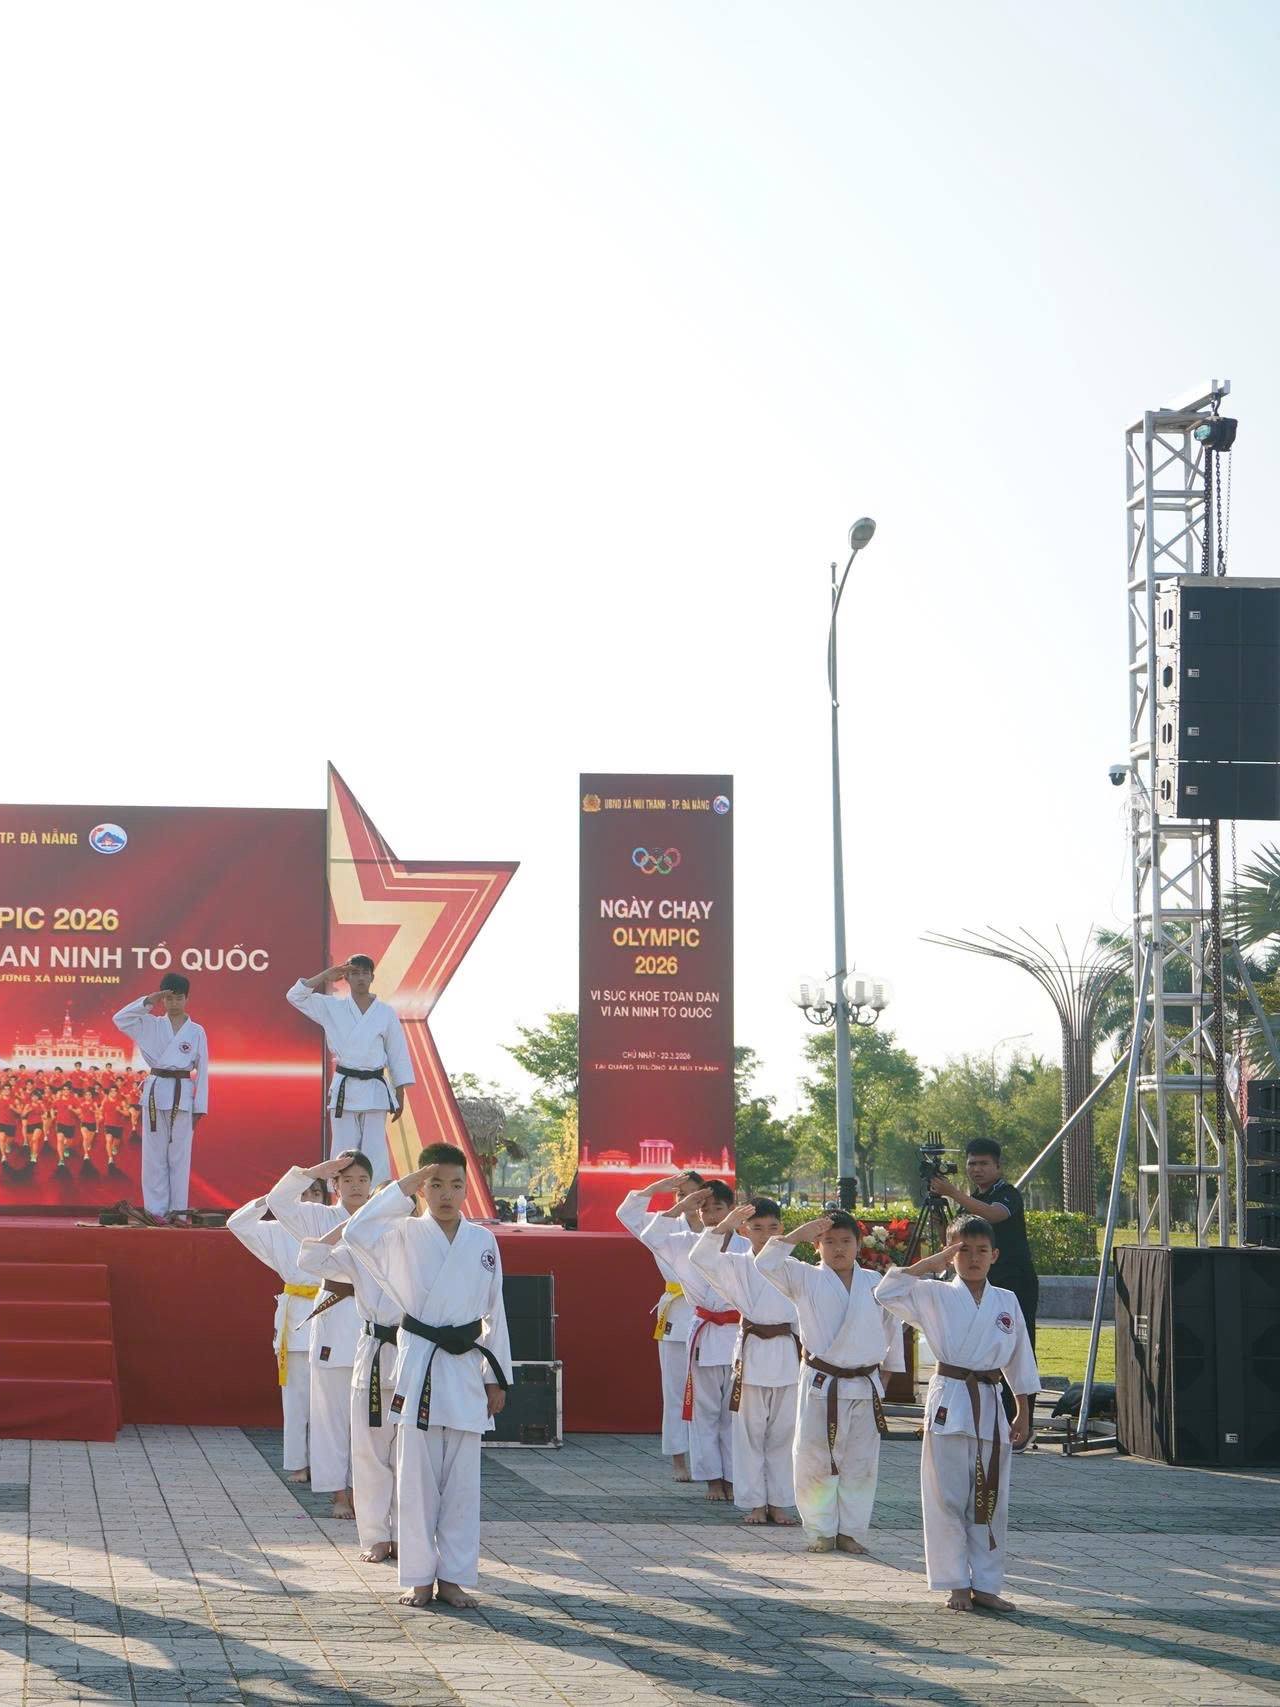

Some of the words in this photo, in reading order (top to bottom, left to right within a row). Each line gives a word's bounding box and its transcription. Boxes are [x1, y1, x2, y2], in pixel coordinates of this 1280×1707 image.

[0, 832, 17, 844] TP.
[20, 830, 38, 845] ĐÀ
[53, 907, 119, 932] 2026
[600, 896, 653, 919] NGÀY
[658, 900, 714, 923] CHẠY
[612, 927, 700, 947] OLYMPIC
[50, 946, 122, 970] NINH
[180, 944, 270, 972] QUỐC
[634, 955, 679, 975] 2026
[614, 1006, 629, 1017] AN
[632, 1006, 659, 1017] NINH
